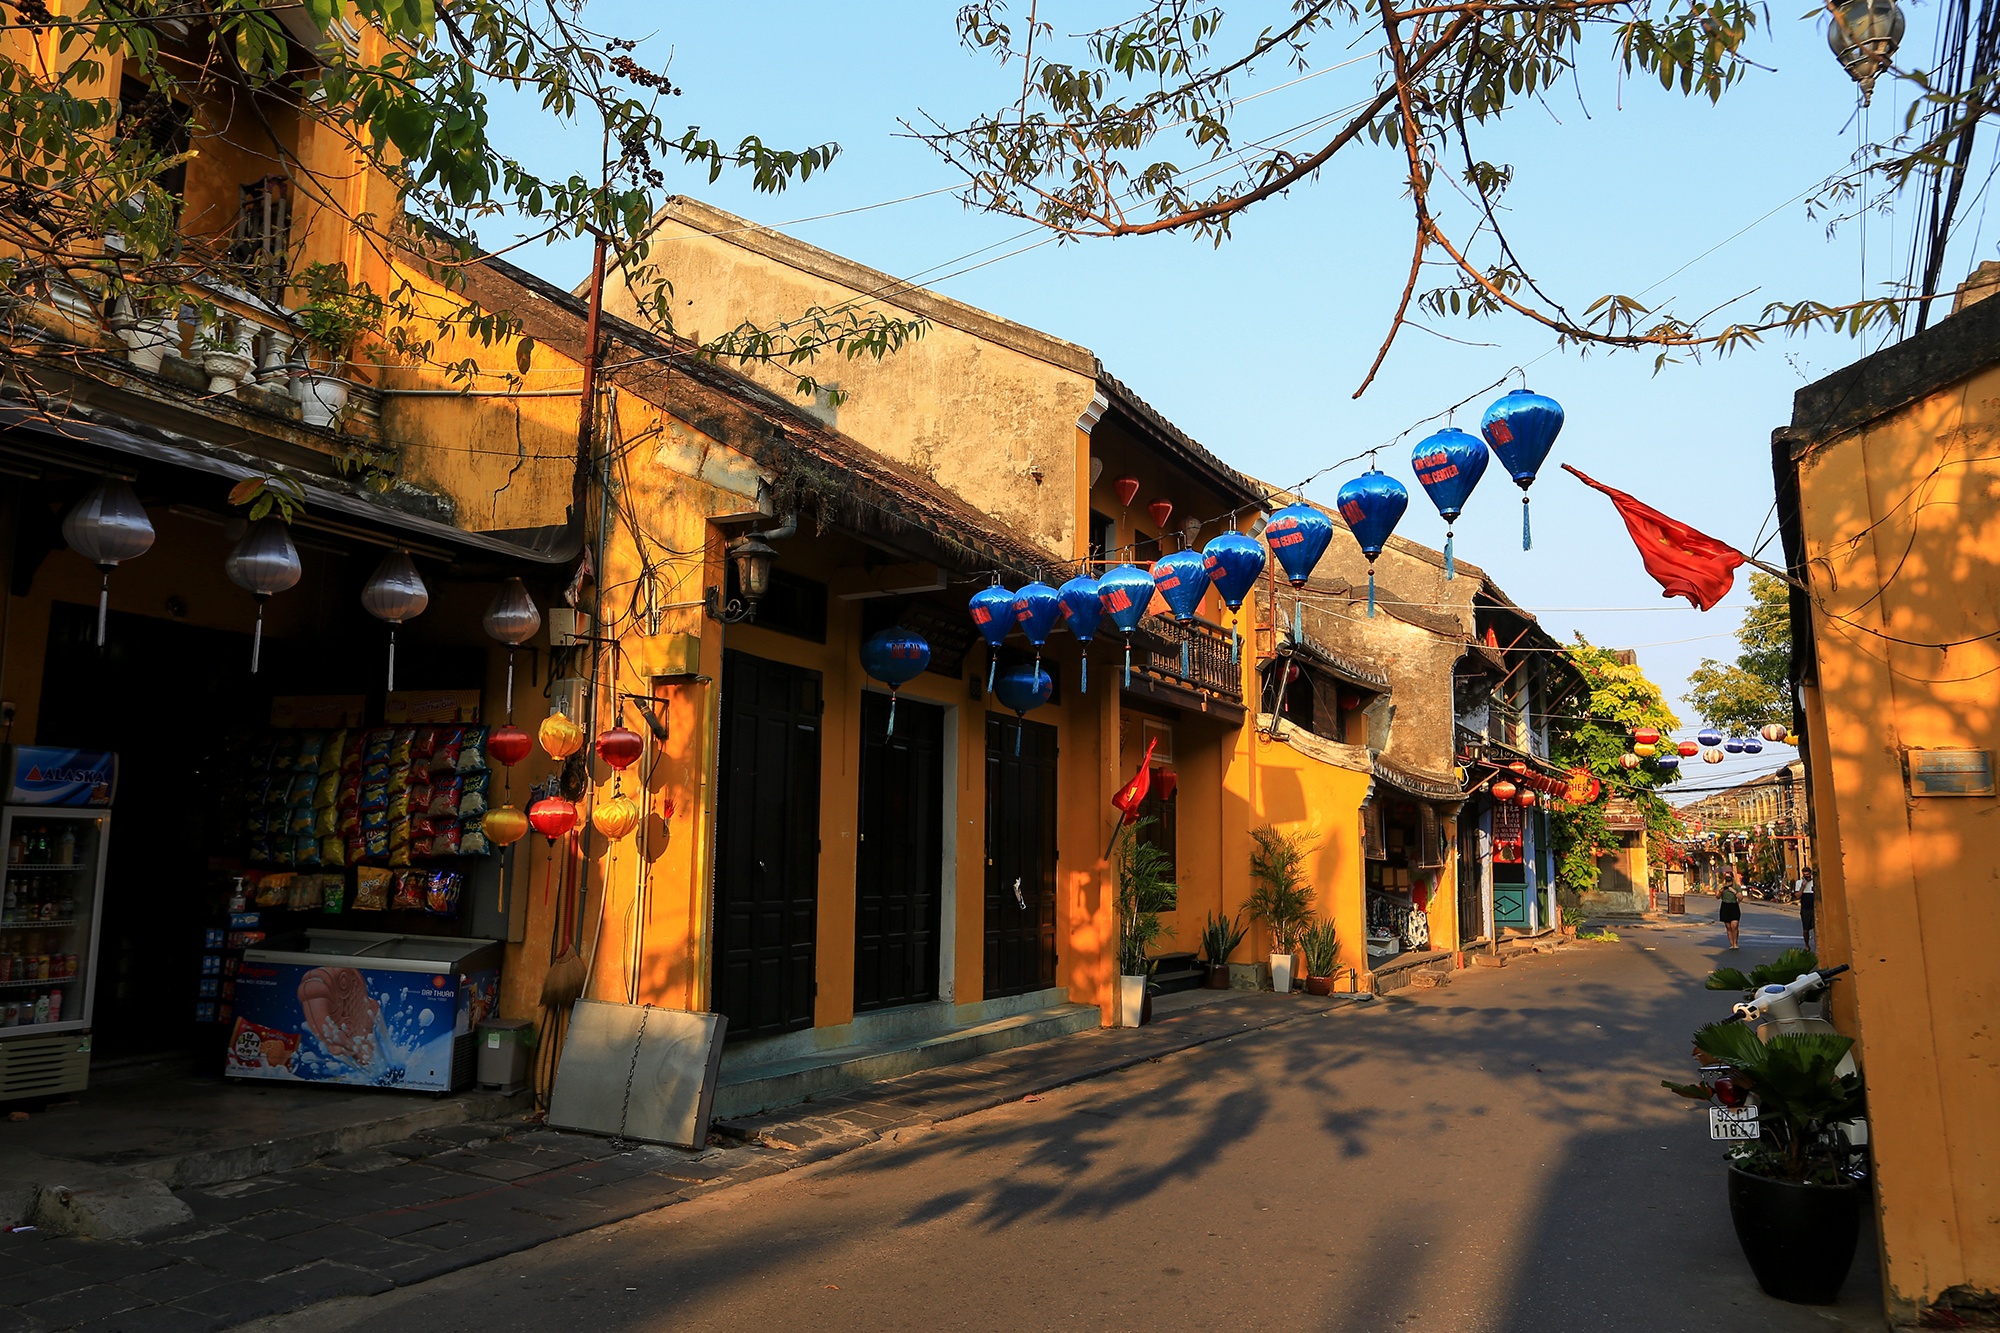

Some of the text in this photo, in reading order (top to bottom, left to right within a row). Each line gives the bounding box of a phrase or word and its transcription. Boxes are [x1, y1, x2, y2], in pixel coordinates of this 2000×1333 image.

[1431, 464, 1459, 483] CENTER
[1279, 531, 1304, 547] CENTER
[44, 768, 105, 784] ALASKA
